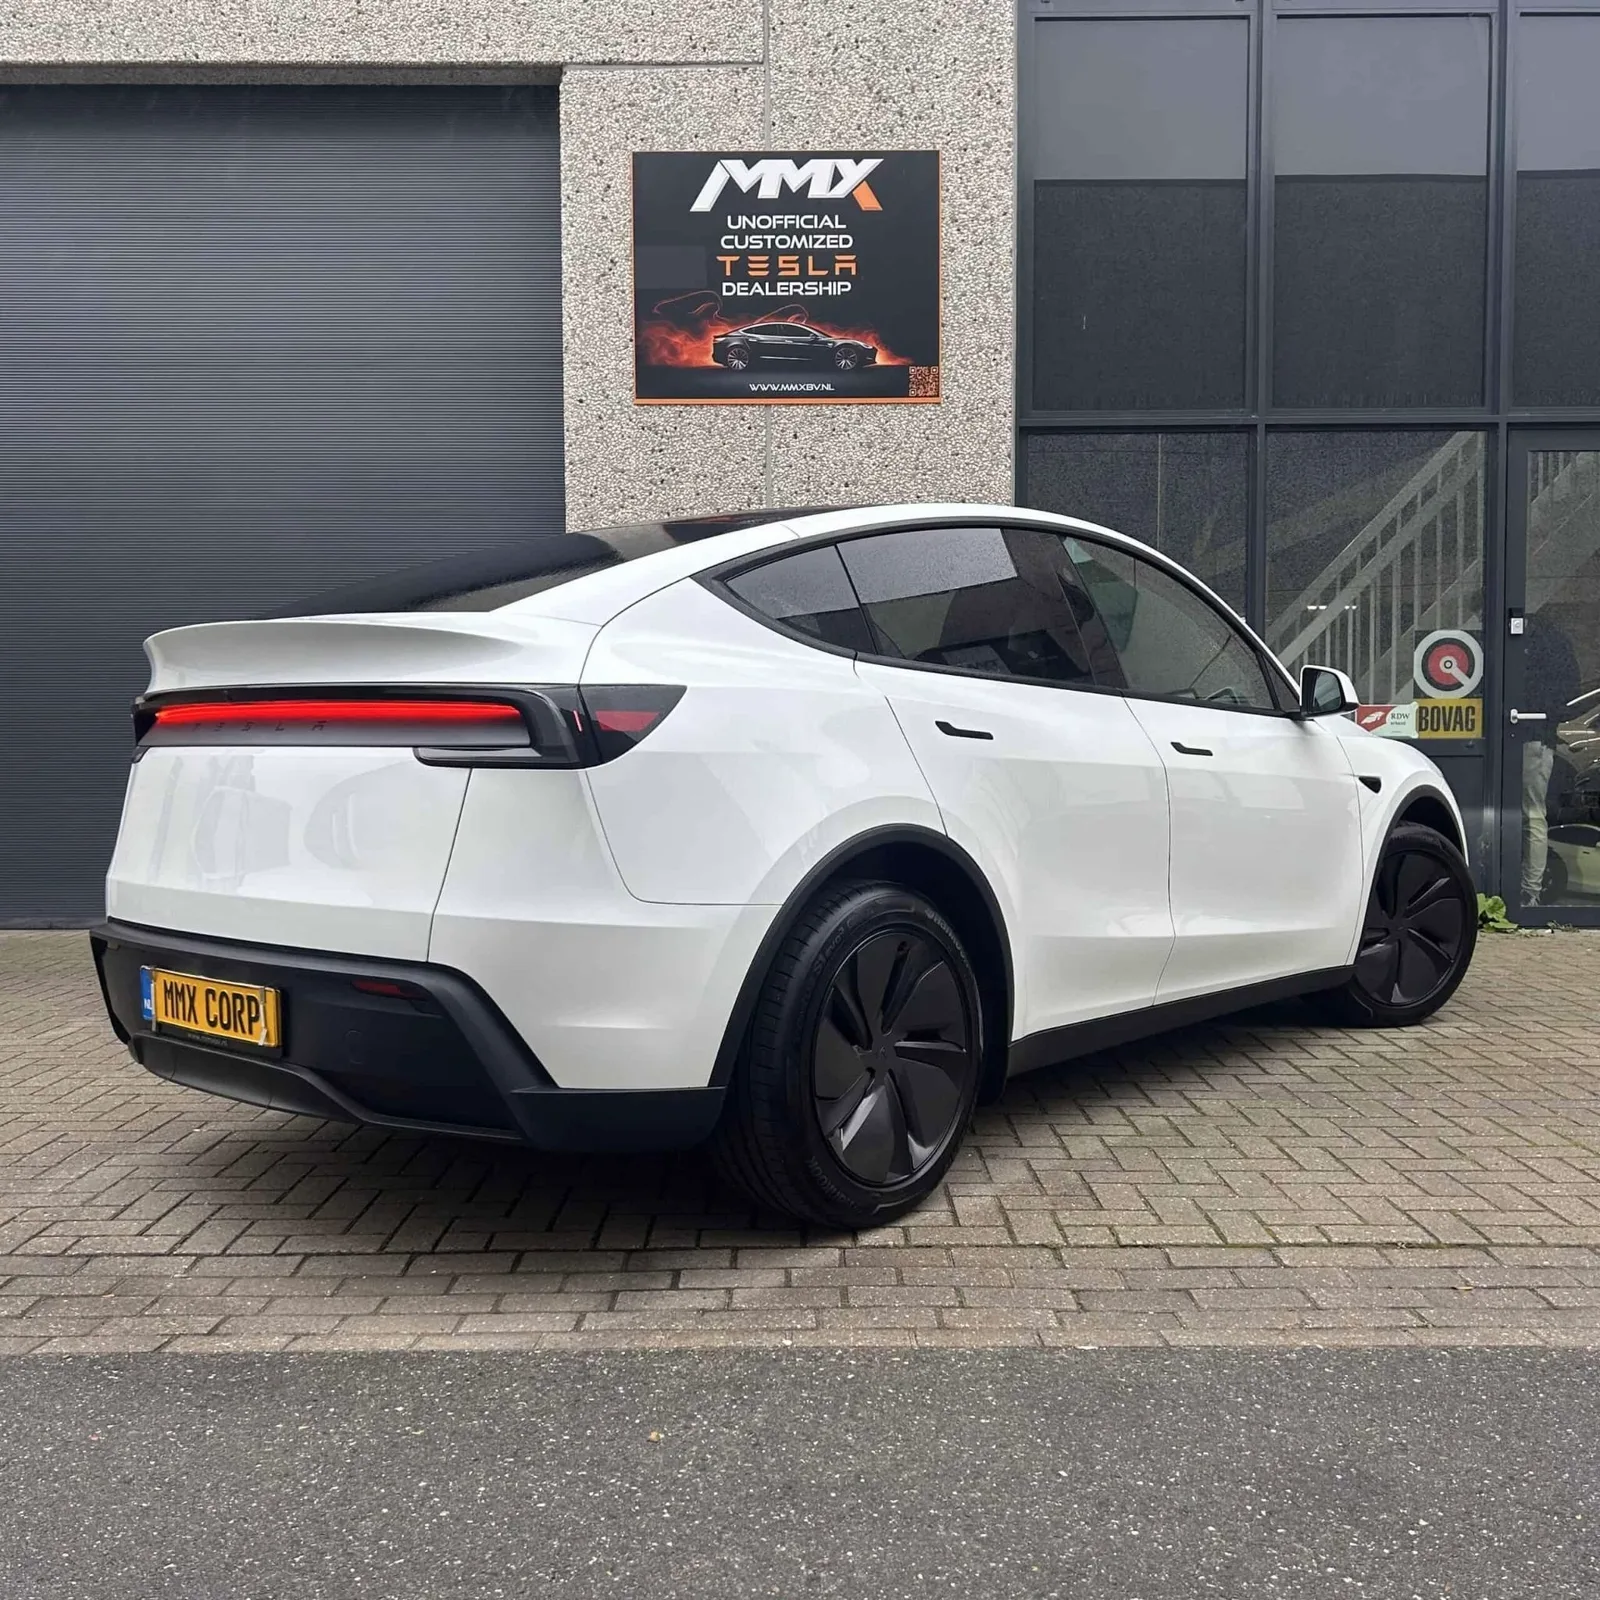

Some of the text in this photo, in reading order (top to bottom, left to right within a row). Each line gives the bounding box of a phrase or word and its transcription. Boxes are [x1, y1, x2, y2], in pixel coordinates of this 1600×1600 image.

[690, 159, 884, 211] MMX
[727, 215, 846, 229] UNOFFICIAL
[720, 235, 853, 249] CUSTOMIZED
[716, 255, 857, 276] TESLA
[722, 281, 852, 296] DEALERSHIP
[749, 383, 835, 391] WWW.MMXBV.NL
[1418, 706, 1475, 732] BOVAG
[143, 997, 153, 1010] NL
[163, 979, 260, 1035] MMX CORP
